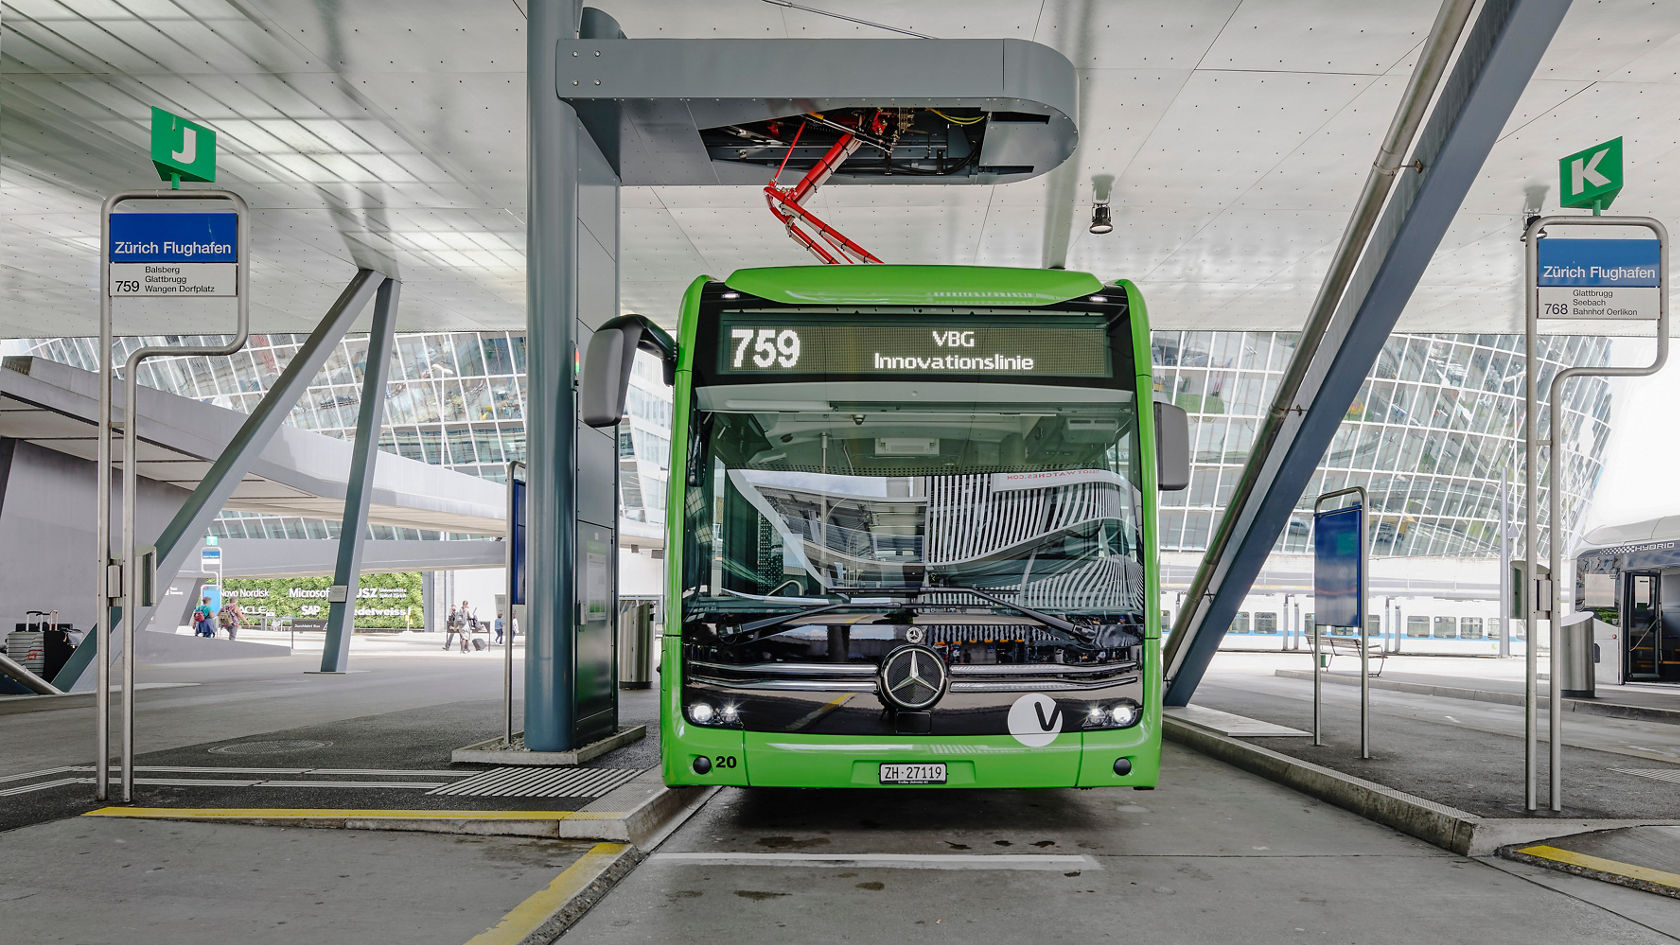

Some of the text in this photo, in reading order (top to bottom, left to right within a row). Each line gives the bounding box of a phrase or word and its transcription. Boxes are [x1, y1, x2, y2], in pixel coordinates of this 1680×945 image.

[172, 127, 197, 165] J
[1571, 147, 1612, 196] K
[114, 241, 231, 257] Zürich Flughafen
[145, 266, 180, 274] Balsberg
[1543, 265, 1656, 281] Zürich Flughafen
[145, 275, 187, 284] Glattbrugg
[115, 280, 140, 293] 759
[145, 285, 215, 294] Wangen Dorfplatz
[1572, 289, 1613, 298] Glattbrugg
[1544, 303, 1569, 315] 768
[1573, 307, 1638, 316] Bahnhof Oerlikon
[932, 331, 975, 347] VBG
[731, 329, 801, 368] 759
[874, 353, 1034, 370] Innovationslinie
[1635, 542, 1675, 552] HYBRID
[240, 588, 270, 597] Nordisk
[289, 588, 331, 598] Microsof
[240, 605, 267, 614] ACLE
[301, 605, 321, 616] SAP
[715, 755, 737, 768] 20
